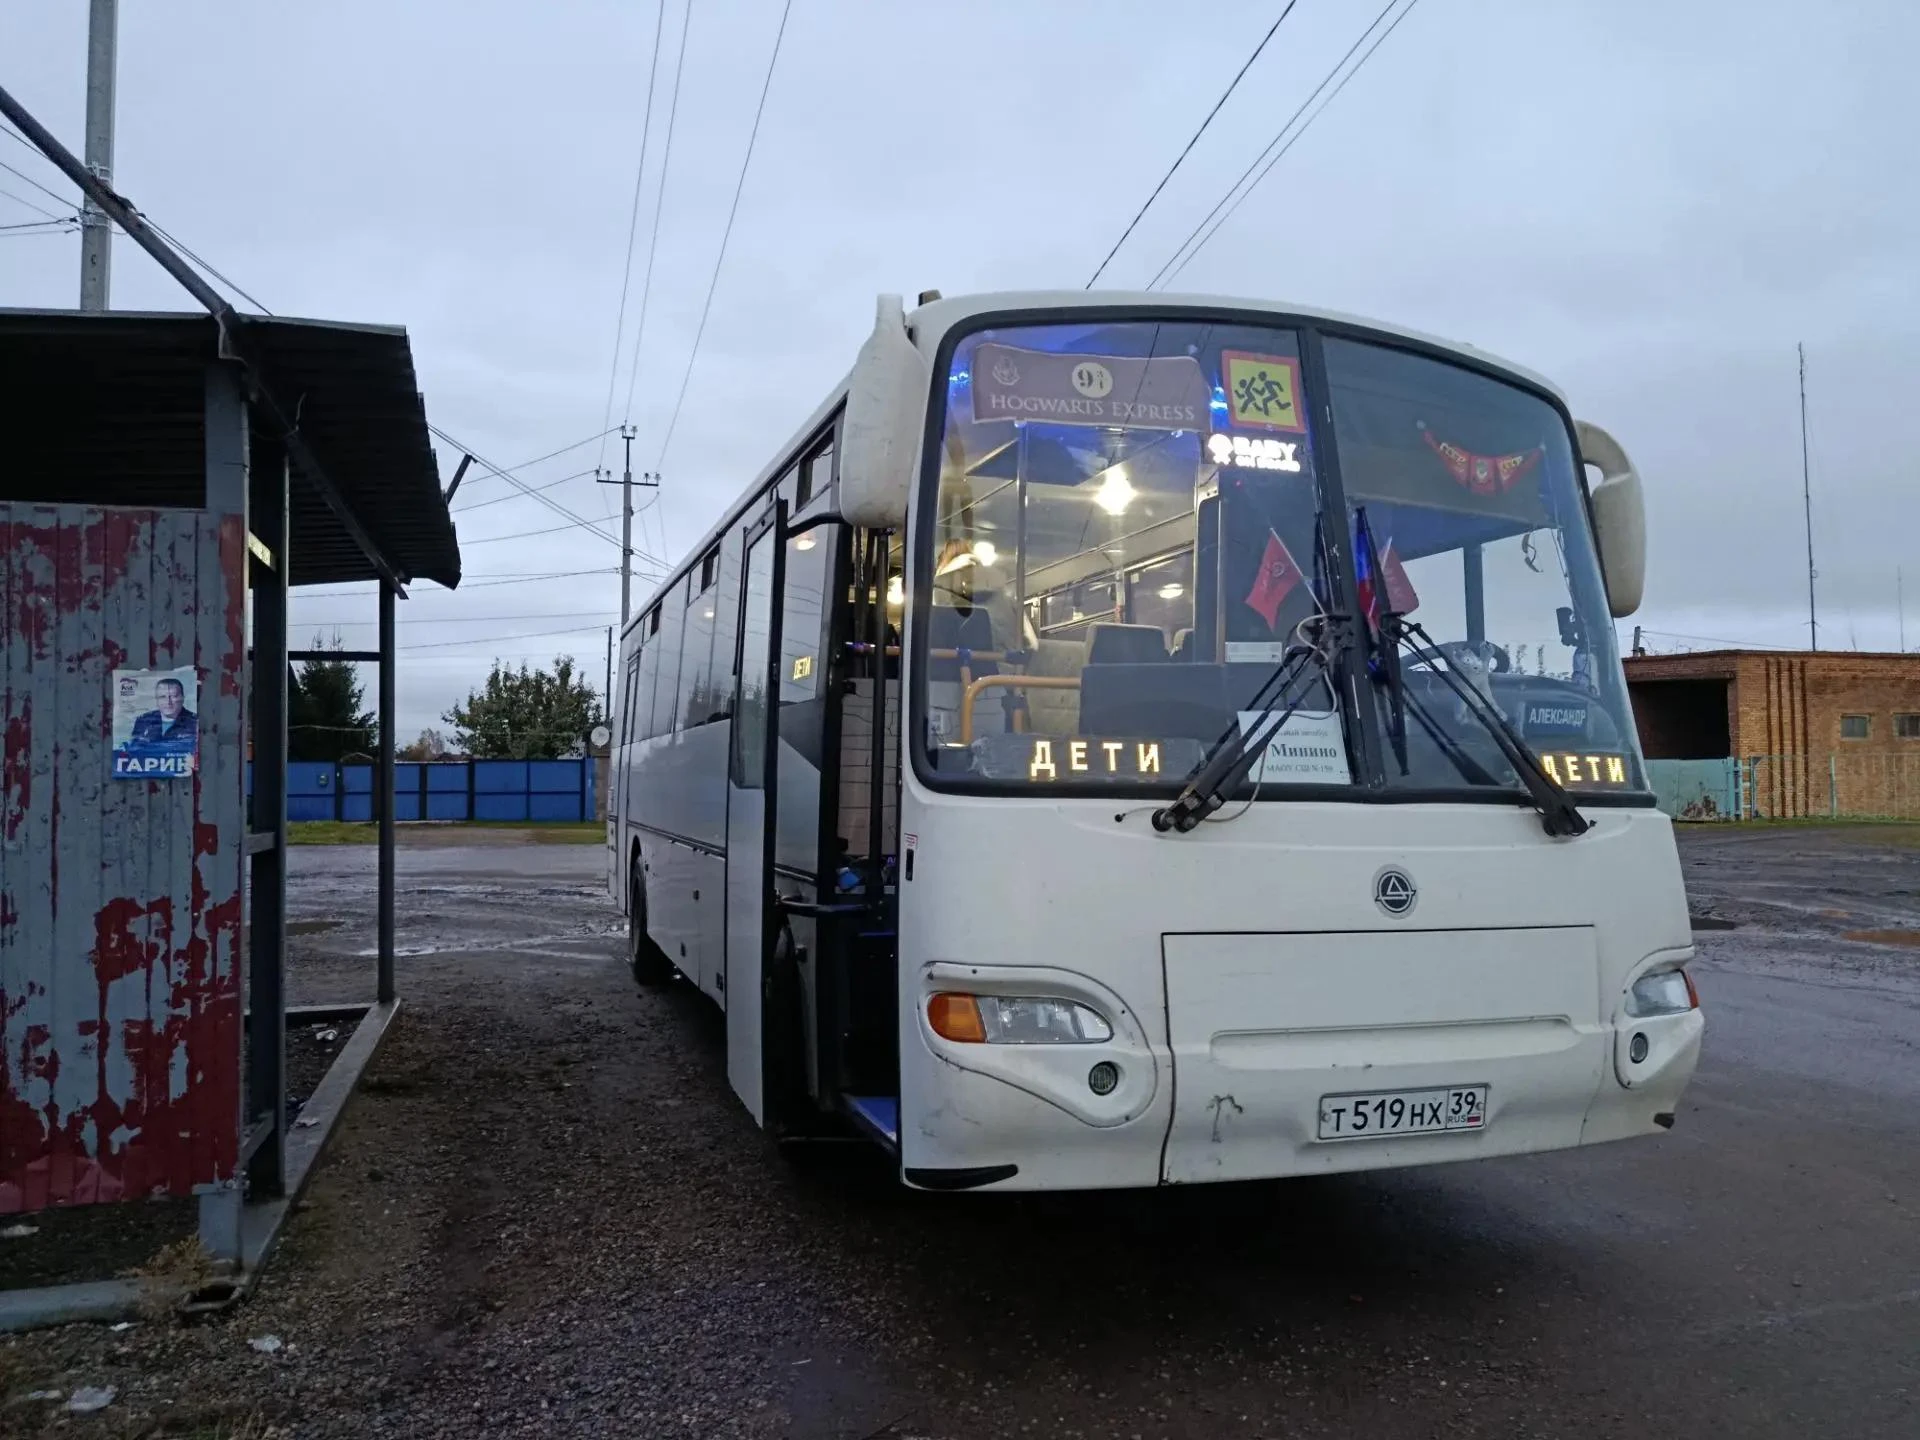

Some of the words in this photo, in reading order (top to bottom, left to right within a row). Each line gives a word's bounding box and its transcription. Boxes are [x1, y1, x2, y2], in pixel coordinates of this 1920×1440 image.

[991, 394, 1104, 416] HOGWARTS
[1111, 401, 1196, 421] EXPRESS
[1528, 707, 1586, 727] АЛЕКСАНДР
[1031, 740, 1160, 778] ДЕТИ
[1271, 743, 1337, 758] Минино
[1451, 1091, 1477, 1115] 39
[1448, 1114, 1466, 1124] RUS
